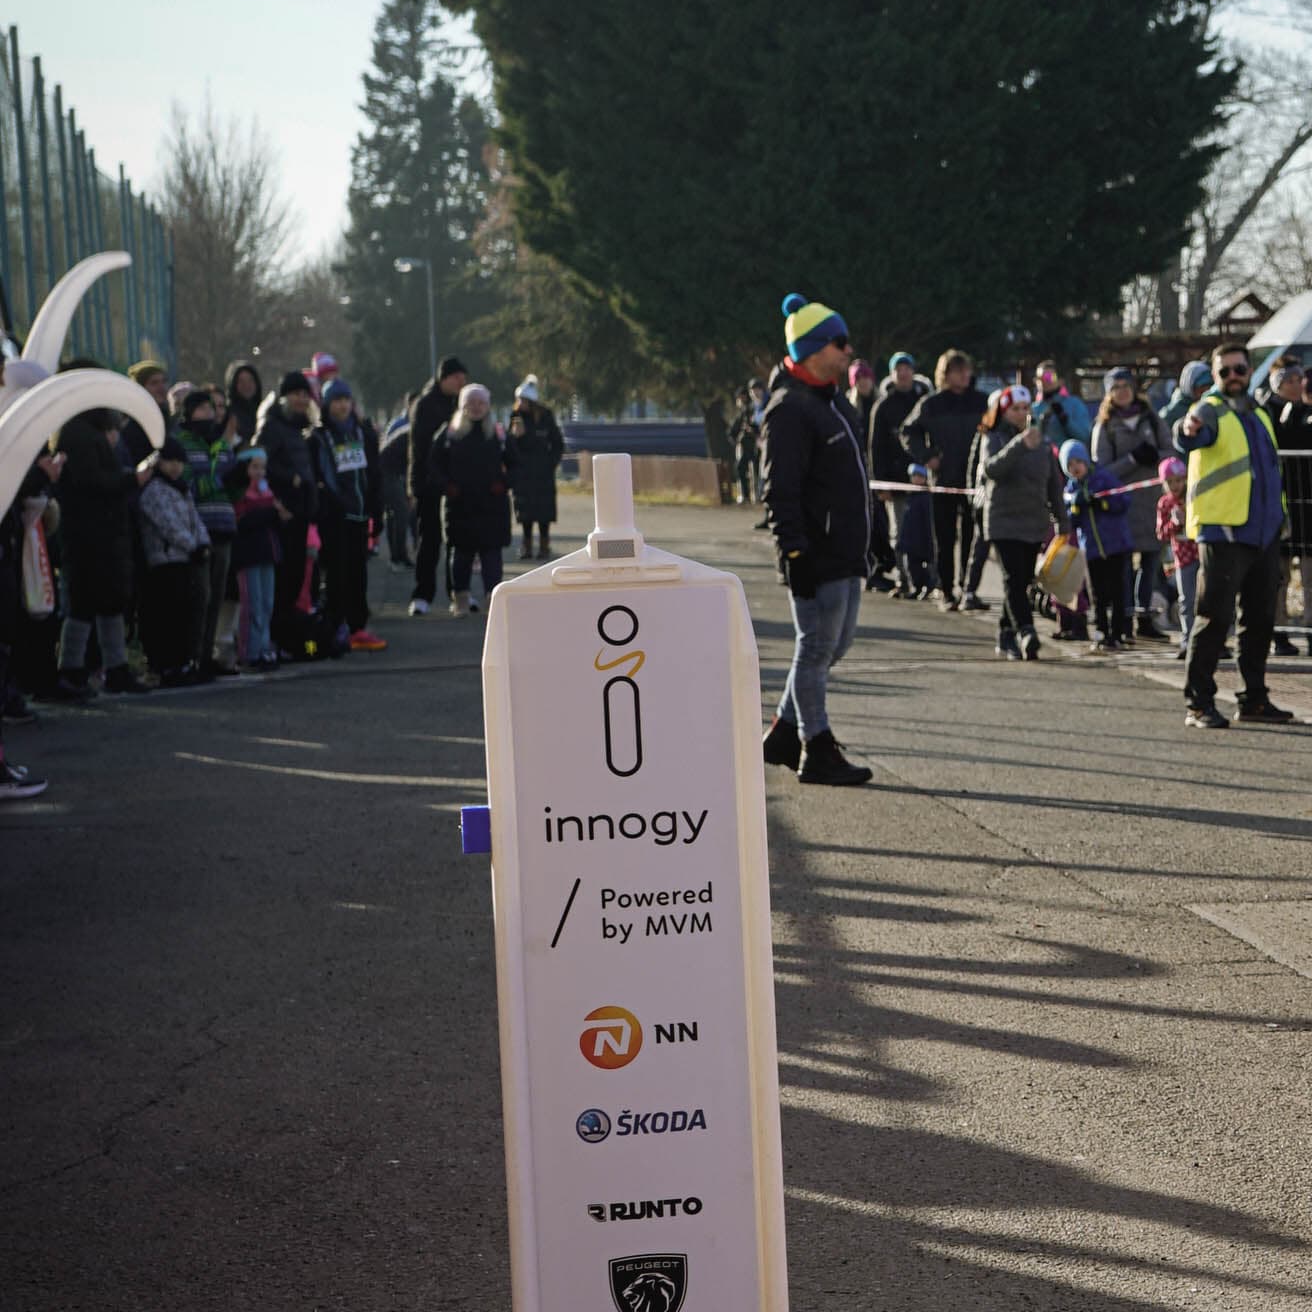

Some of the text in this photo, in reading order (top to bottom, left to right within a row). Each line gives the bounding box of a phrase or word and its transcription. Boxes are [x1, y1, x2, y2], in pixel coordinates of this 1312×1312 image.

[544, 806, 709, 846] innogy
[600, 881, 713, 910] Powered
[602, 911, 713, 945] by MVM
[654, 1021, 699, 1045] NN
[616, 1109, 707, 1136] ŠKODA
[610, 1196, 703, 1221] RUNTO
[616, 1260, 680, 1273] PEUGEOT
